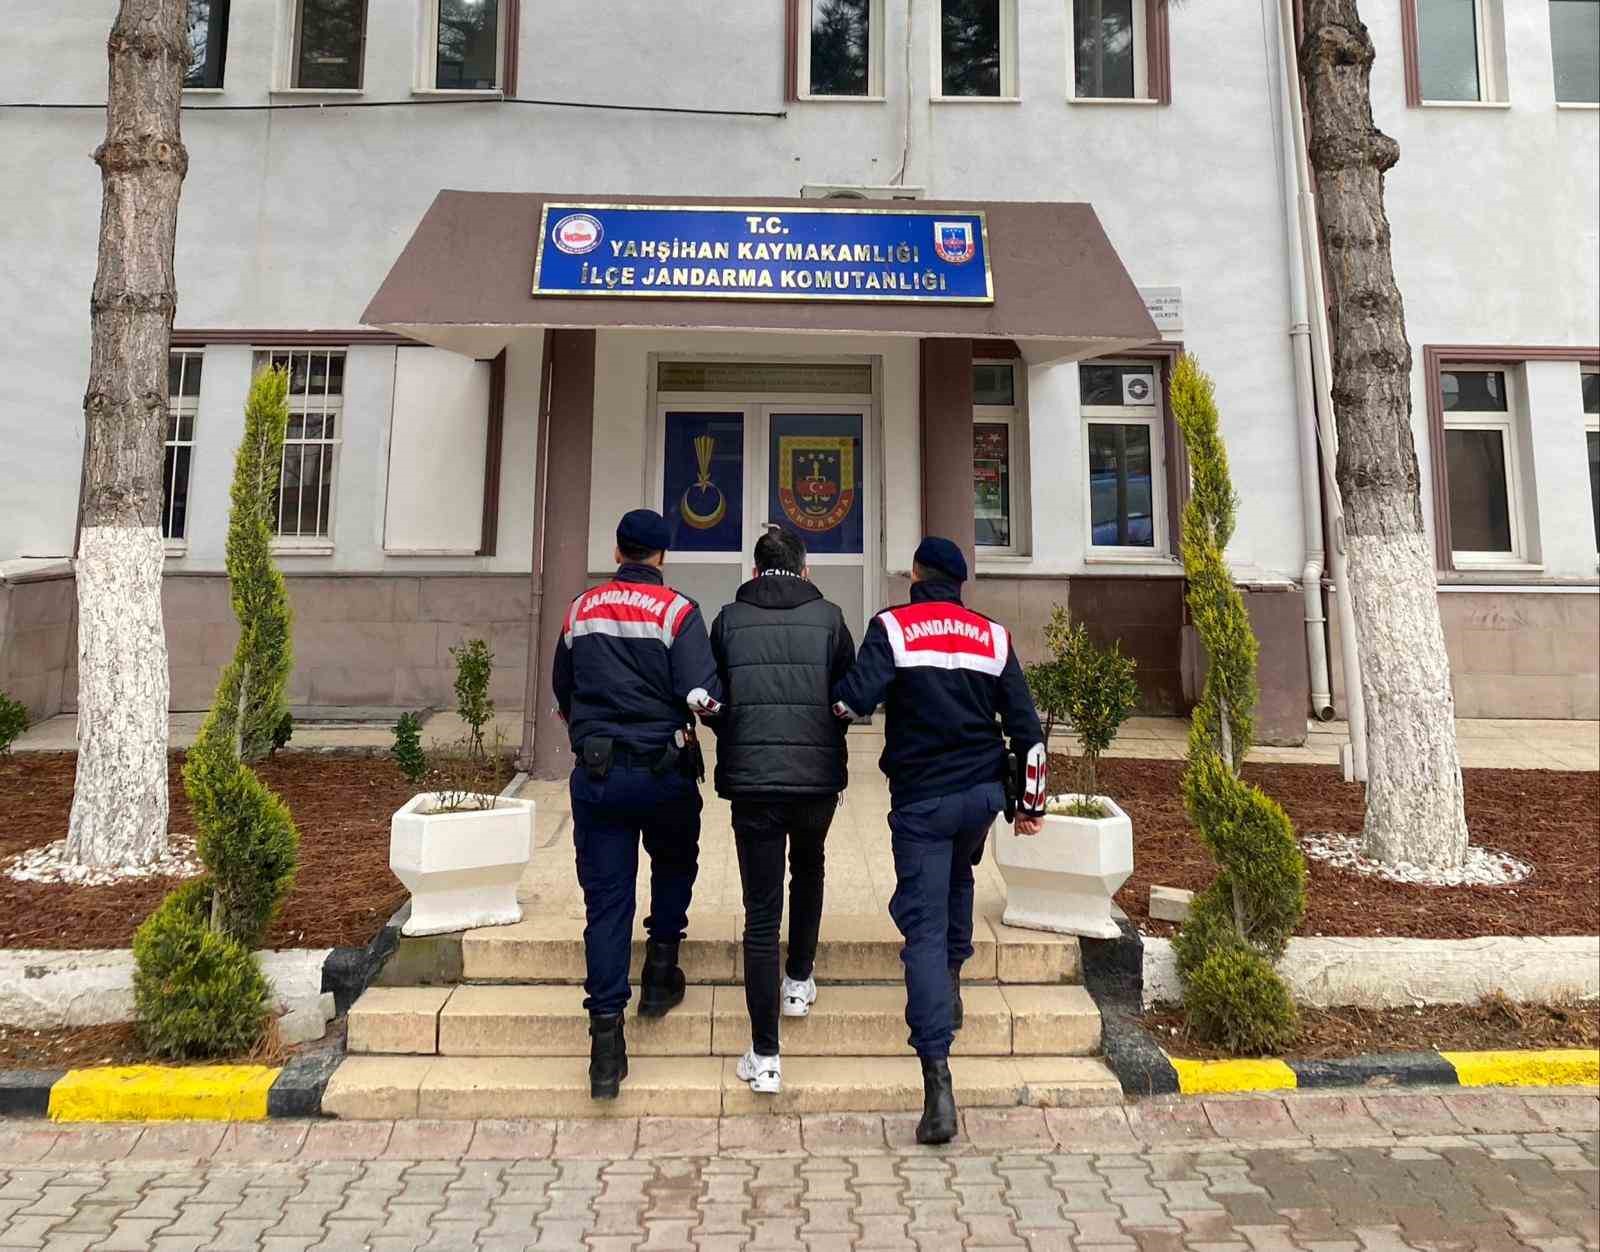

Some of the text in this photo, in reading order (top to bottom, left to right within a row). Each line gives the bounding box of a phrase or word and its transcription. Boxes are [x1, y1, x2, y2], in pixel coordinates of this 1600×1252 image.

[746, 216, 789, 235] T.C.
[610, 238, 729, 262] YAHŞİHAN
[738, 241, 920, 263] KAYMAKAMLIĞI
[580, 262, 947, 291] İLÇE JANDARMA KOMUTANLIĞI
[582, 589, 666, 616] JANDARMA
[904, 618, 990, 647] JANDARMA
